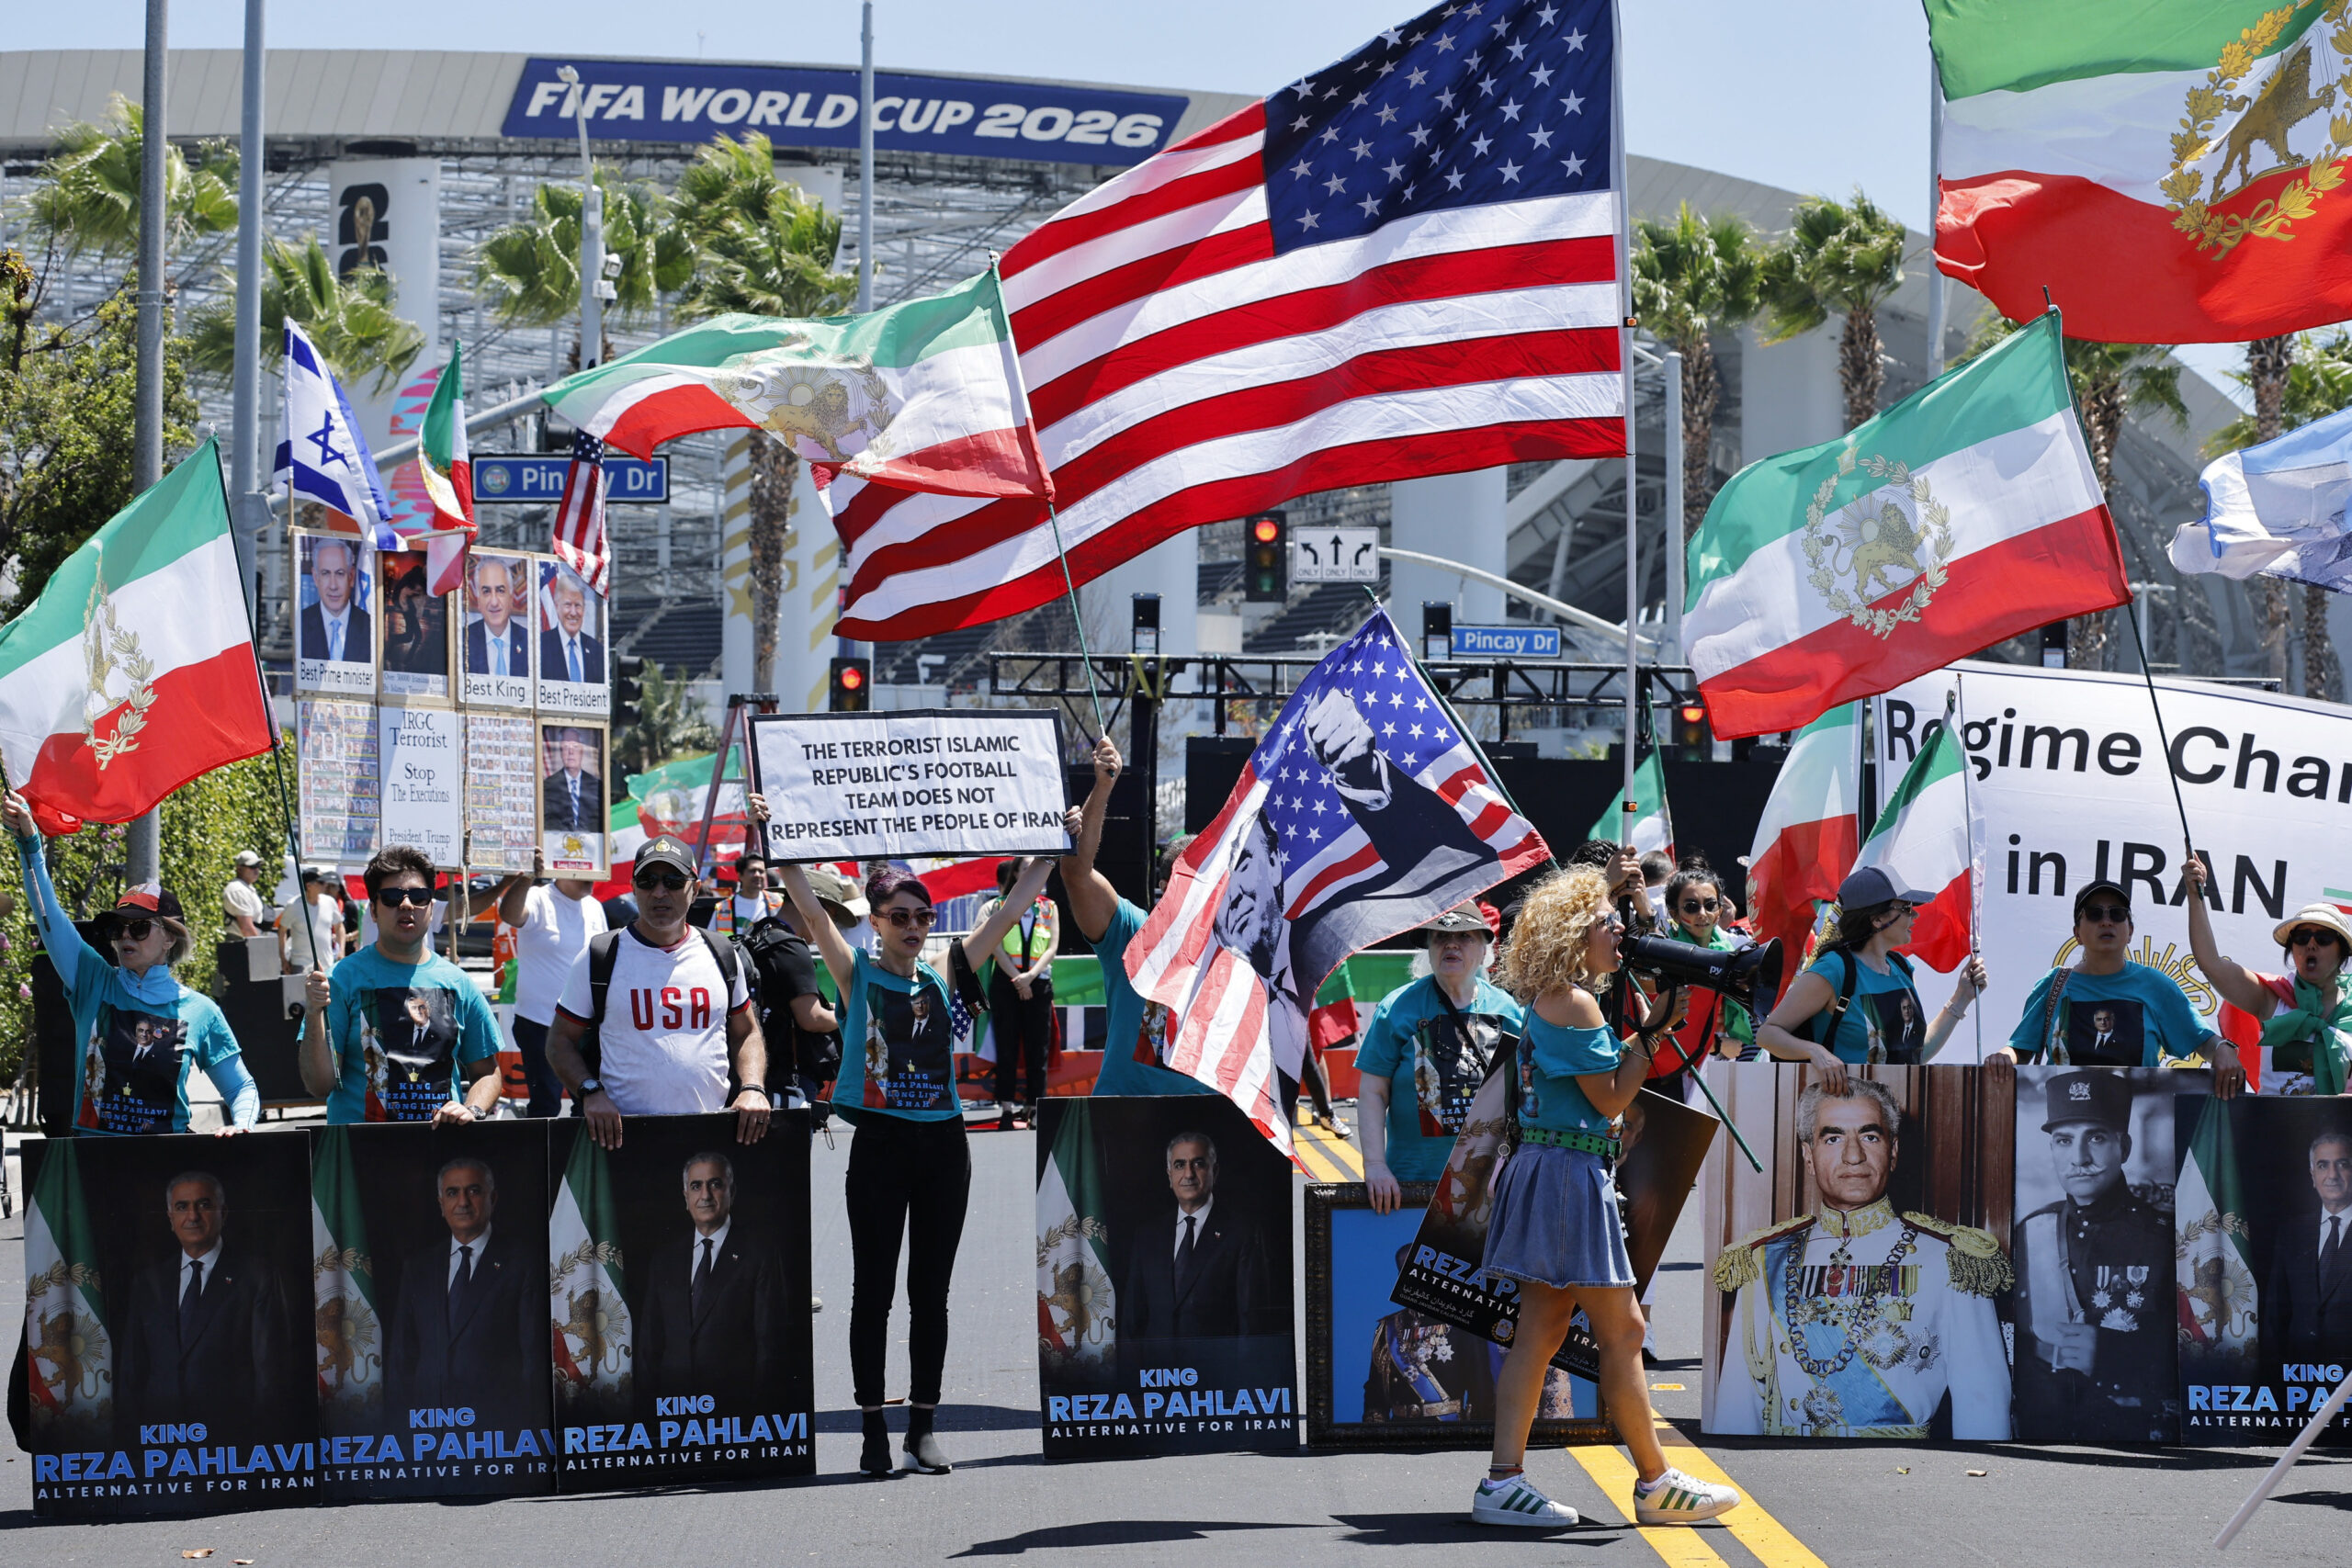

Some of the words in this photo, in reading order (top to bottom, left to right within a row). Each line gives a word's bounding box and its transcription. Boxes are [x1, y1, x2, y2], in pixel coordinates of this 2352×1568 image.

[526, 82, 645, 120] FIFA
[661, 86, 858, 129] WORLD
[873, 96, 975, 134] CUP
[974, 103, 1163, 148] 2026
[522, 466, 615, 496] Piny
[627, 467, 657, 491] Dr
[1464, 631, 1526, 654] Pincay
[1533, 634, 1554, 650] Dr
[300, 661, 317, 681] Best
[320, 663, 341, 683] Prime
[343, 668, 373, 685] minister
[465, 679, 492, 696] Best
[496, 680, 526, 703] King
[540, 685, 560, 705] Best
[564, 688, 606, 707] President
[402, 711, 434, 731] IRGC
[390, 728, 447, 749] Terrorist
[801, 743, 838, 761] THE
[841, 738, 942, 759] TERRORIST
[946, 736, 1020, 753] ISLAMIC
[404, 762, 435, 785] Stop
[812, 764, 919, 786] REPUBLIC'S
[924, 761, 1017, 779] FOOTBALL
[390, 784, 406, 802] The
[410, 784, 449, 803] Executions
[844, 791, 898, 809] TEAM
[902, 788, 953, 806] DOES
[957, 787, 995, 804] NOT
[772, 818, 878, 840] REPRESENT
[885, 816, 916, 833] THE
[922, 813, 989, 831] PEOPLE
[997, 812, 1019, 829] OF
[1023, 811, 1066, 828] IRAN
[390, 829, 423, 842] President
[425, 829, 451, 848] Trump
[435, 847, 447, 863] Job
[2007, 833, 2066, 896] in
[630, 987, 710, 1031] USA
[399, 1082, 431, 1090] KING
[899, 1072, 929, 1080] KING
[910, 1081, 944, 1090] PAHLAVI
[113, 1094, 143, 1105] KING
[123, 1104, 167, 1116] PAHLAVI
[897, 1100, 930, 1108] SHAH
[101, 1111, 128, 1122] LONG
[398, 1111, 433, 1120] SHAH
[108, 1122, 142, 1133] SHAH
[1414, 1244, 1487, 1292] REZA
[1408, 1269, 1521, 1319] ALTERNATIV
[1574, 1334, 1600, 1351] IRA
[1140, 1367, 1198, 1388] KING
[2283, 1363, 2344, 1382] KING
[656, 1394, 715, 1416] KING
[1049, 1393, 1136, 1422] REZA
[1144, 1387, 1290, 1418] PAHLAVI
[2188, 1385, 2278, 1411] REZA
[409, 1407, 476, 1428] KING
[1051, 1422, 1186, 1438] ALTERNATIVE
[1198, 1421, 1233, 1433] FOR
[1245, 1418, 1291, 1430] IRAN
[141, 1423, 208, 1445] KING
[564, 1423, 652, 1454] REZA
[660, 1413, 807, 1449] PAHLAVI
[413, 1429, 556, 1461] PAHLAV
[35, 1451, 135, 1483] REZA
[144, 1443, 314, 1477] PAHLAVI
[566, 1451, 702, 1471] ALTERNATIVE
[714, 1449, 750, 1461] FOR
[762, 1445, 808, 1458] IRAN
[324, 1466, 460, 1482] LTERNATIVE
[474, 1463, 514, 1475] FOR
[528, 1462, 557, 1473] IR
[38, 1482, 193, 1499] ALTERNATIVE
[207, 1479, 248, 1492] FOR
[261, 1476, 314, 1489] IRAN
